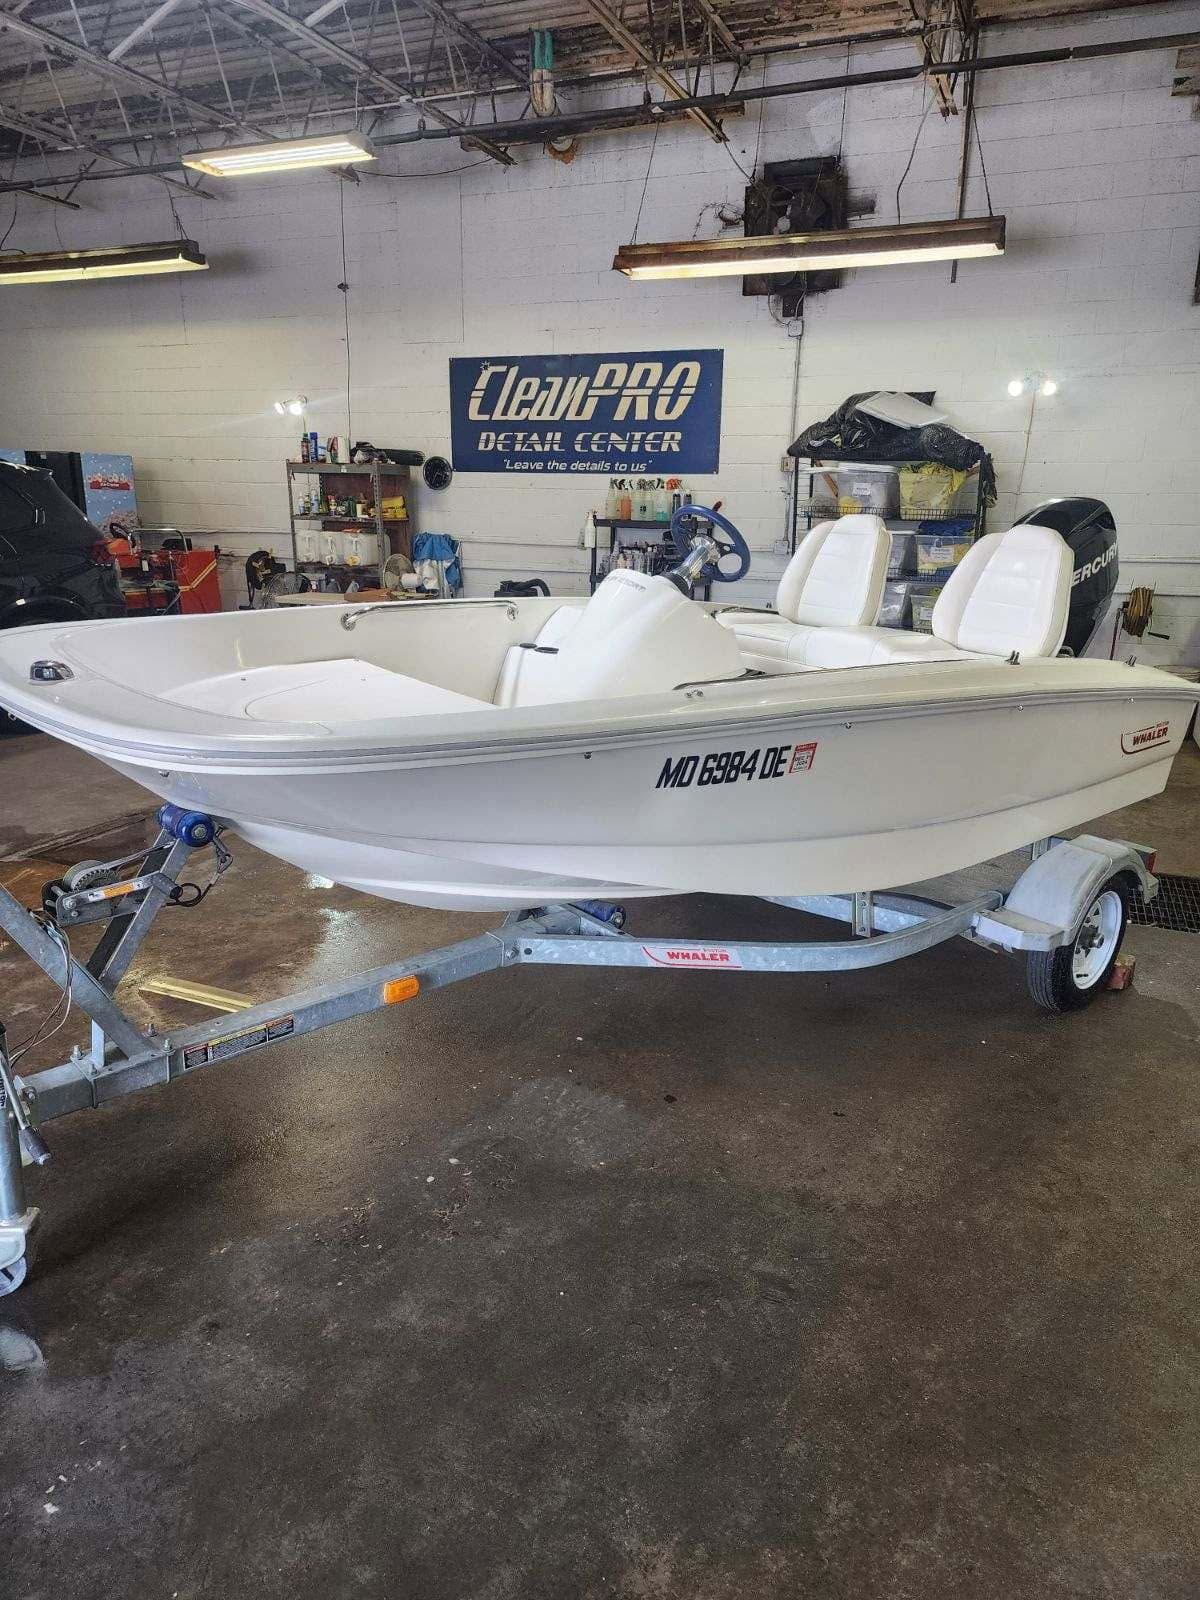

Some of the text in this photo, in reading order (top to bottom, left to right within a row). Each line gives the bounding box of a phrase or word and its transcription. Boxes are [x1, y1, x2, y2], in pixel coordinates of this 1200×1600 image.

[478, 431, 682, 453] DETAIL CENTER
[547, 460, 567, 471] the
[570, 460, 611, 471] details
[614, 461, 627, 471] to
[1071, 542, 1118, 585] ERCURY
[1132, 727, 1169, 746] WHALER
[656, 745, 792, 788] MD 6984 DE
[667, 951, 730, 961] WHALER
